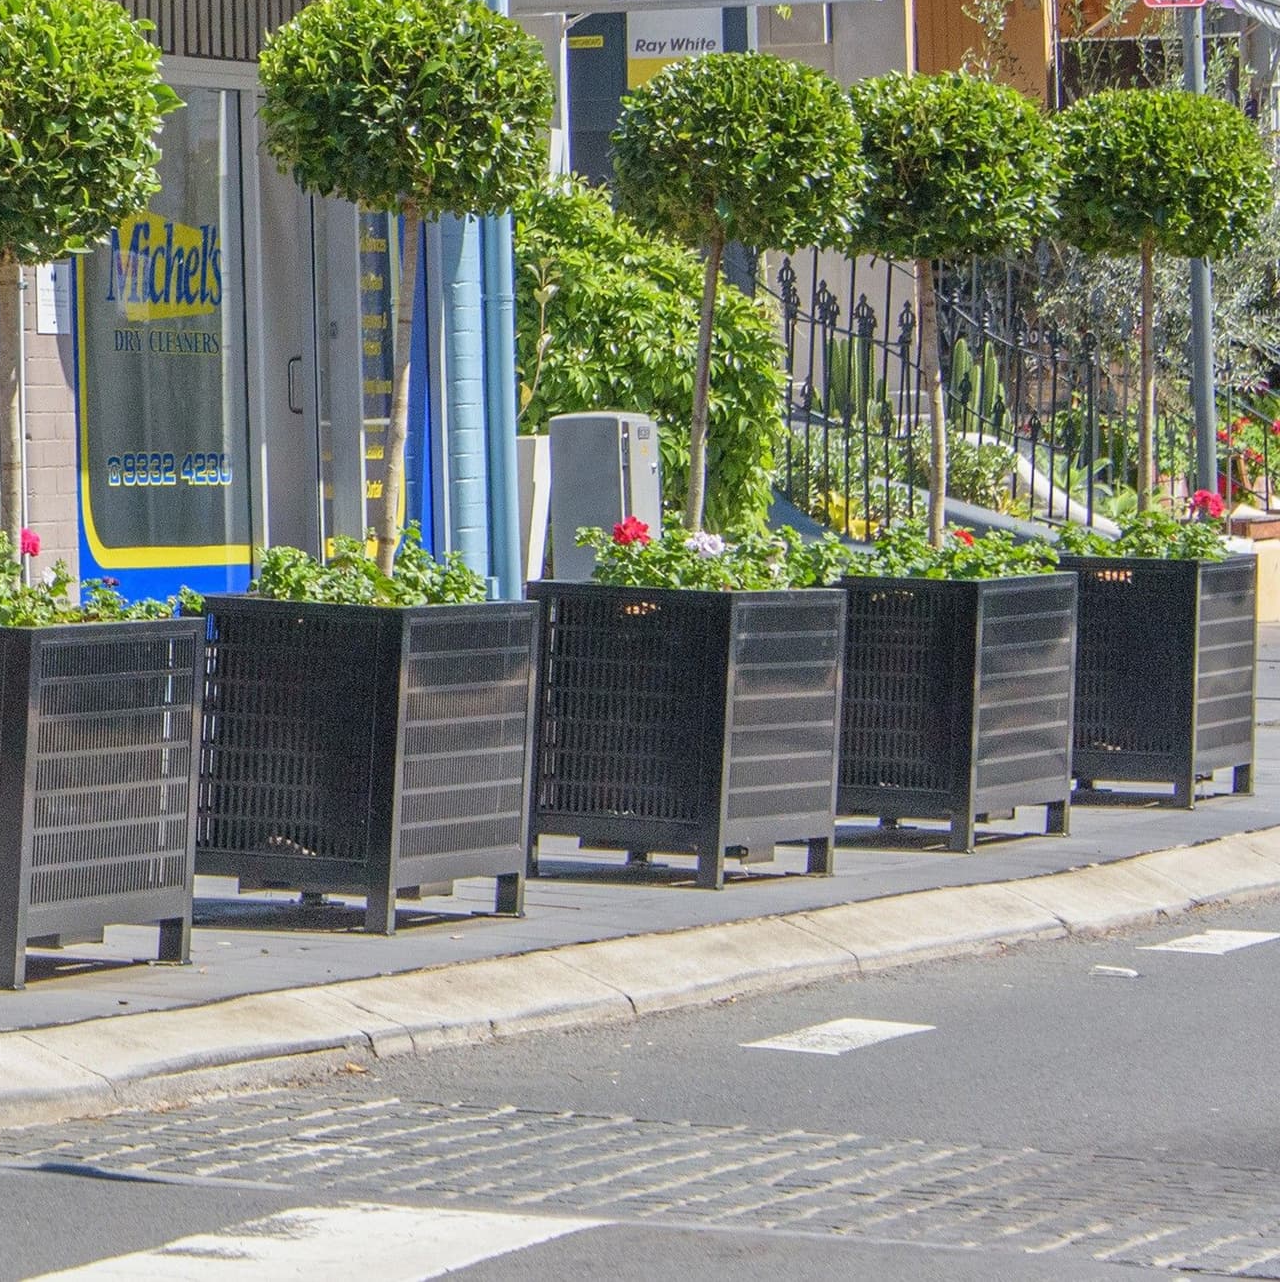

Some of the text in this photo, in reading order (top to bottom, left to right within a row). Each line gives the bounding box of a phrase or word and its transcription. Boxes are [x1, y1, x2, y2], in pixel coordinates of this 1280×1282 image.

[635, 37, 716, 54] Ray White
[106, 222, 223, 306] Michel's
[114, 329, 219, 355] DRY CLEANERS
[123, 452, 176, 486] 9332
